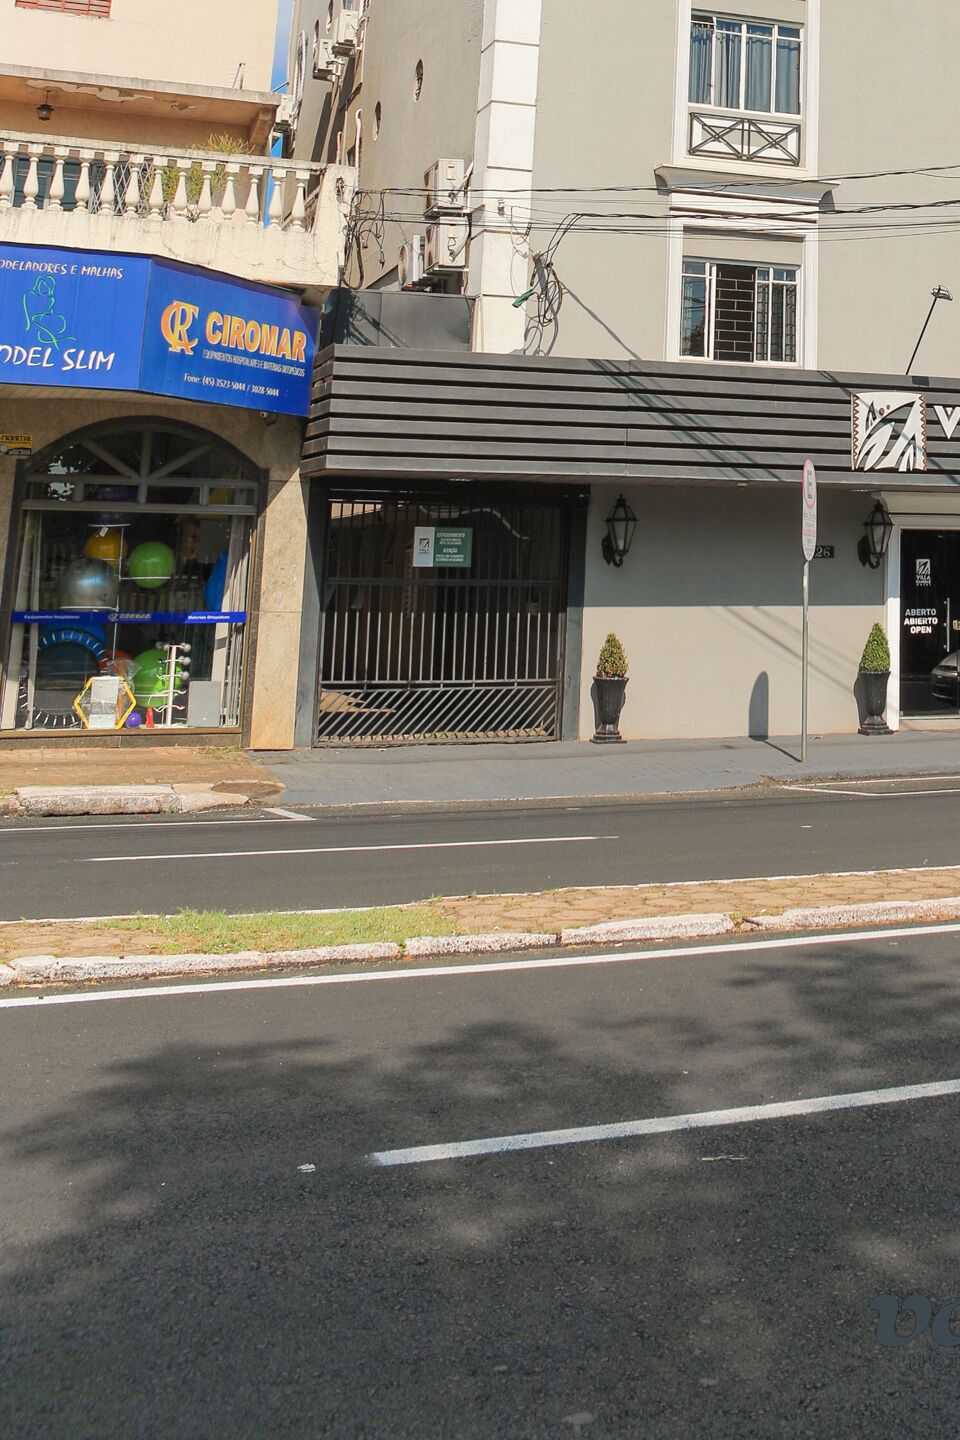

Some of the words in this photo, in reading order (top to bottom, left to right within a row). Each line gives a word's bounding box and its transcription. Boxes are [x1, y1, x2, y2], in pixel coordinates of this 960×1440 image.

[70, 265, 78, 274] E
[81, 265, 124, 279] MALHAS
[205, 311, 306, 363] CIROMAR
[61, 348, 116, 371] SLIM
[183, 373, 201, 384] Fone:
[202, 375, 215, 387] (45)
[216, 379, 246, 392] 3523-5044
[905, 608, 937, 616] ABERTO
[904, 617, 938, 625] ABIERTO
[910, 625, 932, 634] OPEN
